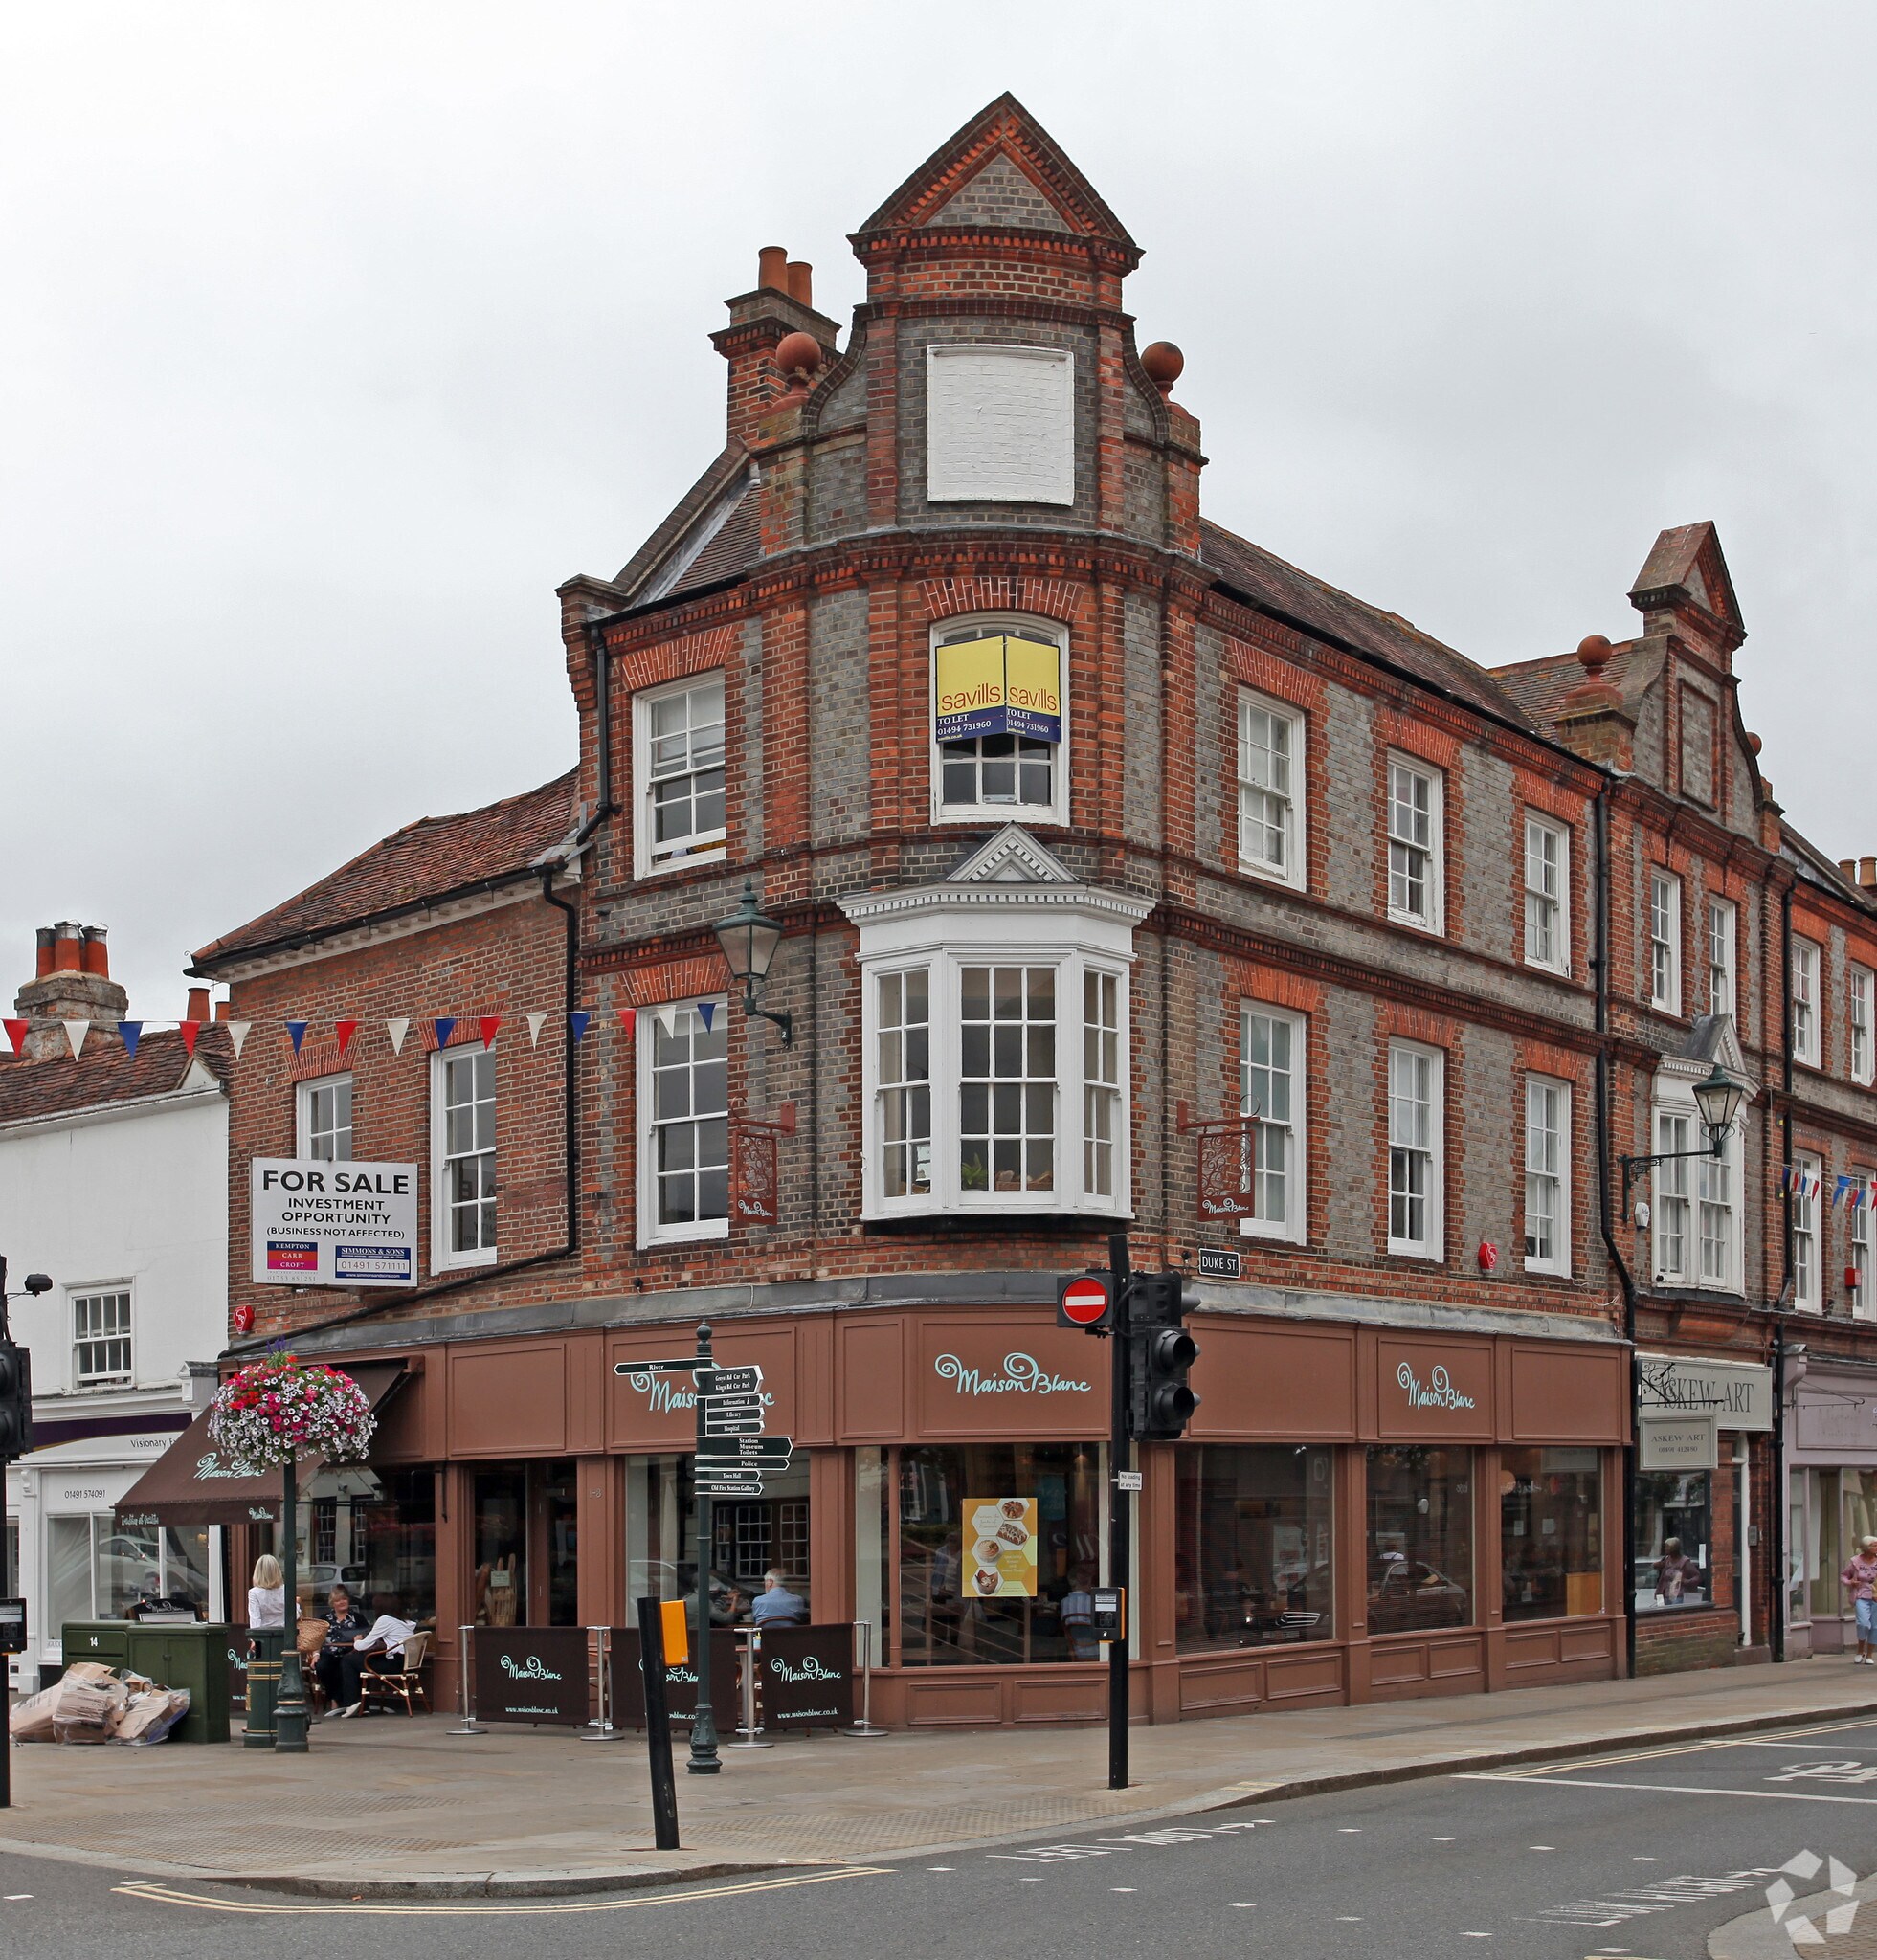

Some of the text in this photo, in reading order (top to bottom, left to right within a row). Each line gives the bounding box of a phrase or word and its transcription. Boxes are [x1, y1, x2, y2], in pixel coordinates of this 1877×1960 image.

[941, 683, 1001, 711] savills
[1009, 686, 1057, 711] savills
[938, 714, 970, 725] TO LET
[1007, 708, 1032, 720] TO LET
[937, 720, 992, 736] 01494 731960
[1026, 722, 1049, 733] 731960
[263, 1169, 410, 1195] FOR SALE
[288, 1197, 385, 1211] INVESTMENT
[1202, 1199, 1231, 1214] Maison
[281, 1212, 391, 1225] OPPORTUNITY
[266, 1227, 322, 1236] (BUSINESS
[348, 1230, 405, 1239] AFFECTED)
[341, 1261, 407, 1271] 01491 571111
[1201, 1256, 1239, 1271] DUKE ST.
[934, 1353, 1030, 1396] Maison
[1397, 1362, 1445, 1410] Maison
[1656, 1377, 1754, 1413] ASKEW ART
[130, 1437, 167, 1449] Visionary
[193, 1452, 234, 1481] Maison
[64, 1489, 105, 1500] 01491 574091
[741, 1484, 755, 1493] Gallery
[89, 1637, 98, 1647] 14
[500, 1655, 538, 1680] Maison
[771, 1658, 815, 1682] Maison
[777, 1707, 838, 1719] www.maisonblanc.co.uk
